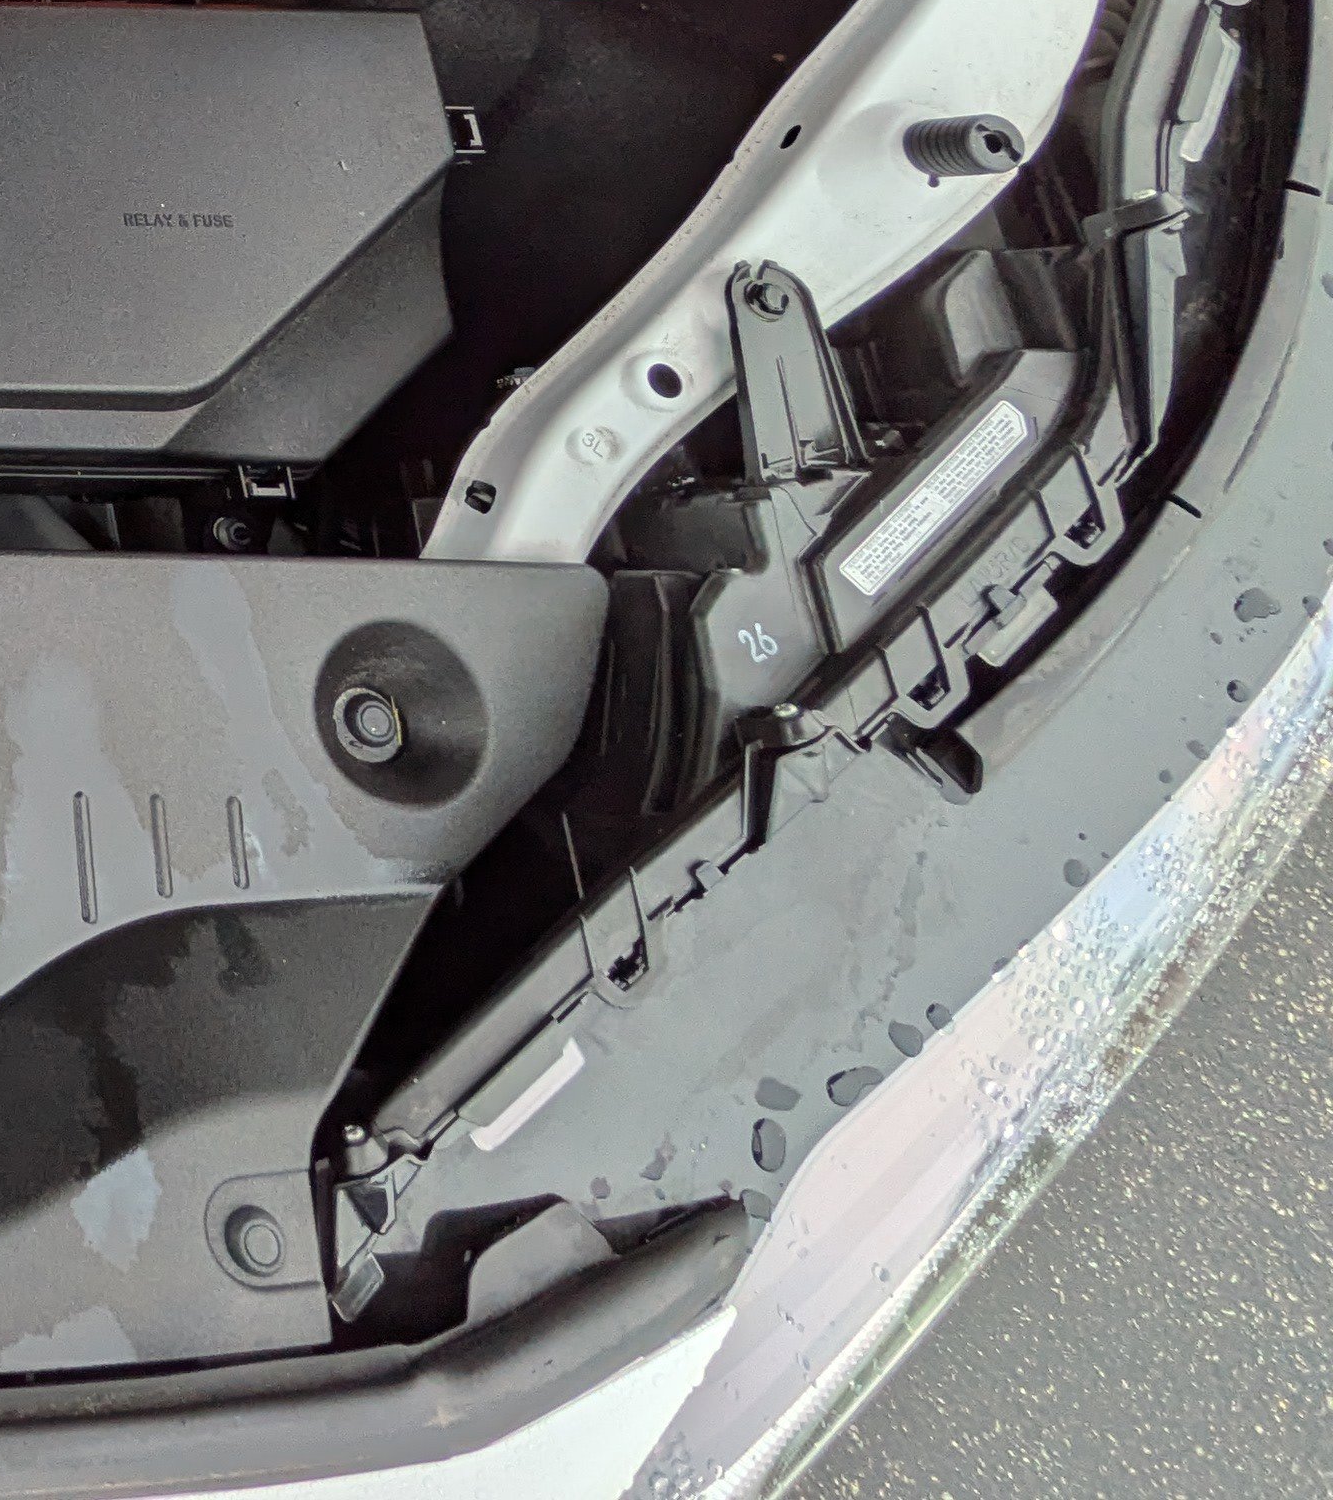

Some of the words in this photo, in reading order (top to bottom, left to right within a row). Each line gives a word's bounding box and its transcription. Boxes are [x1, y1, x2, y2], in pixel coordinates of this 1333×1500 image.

[123, 212, 173, 228] RELAY
[178, 213, 189, 228] &
[192, 213, 234, 228] FUSE
[738, 622, 778, 662] 26
